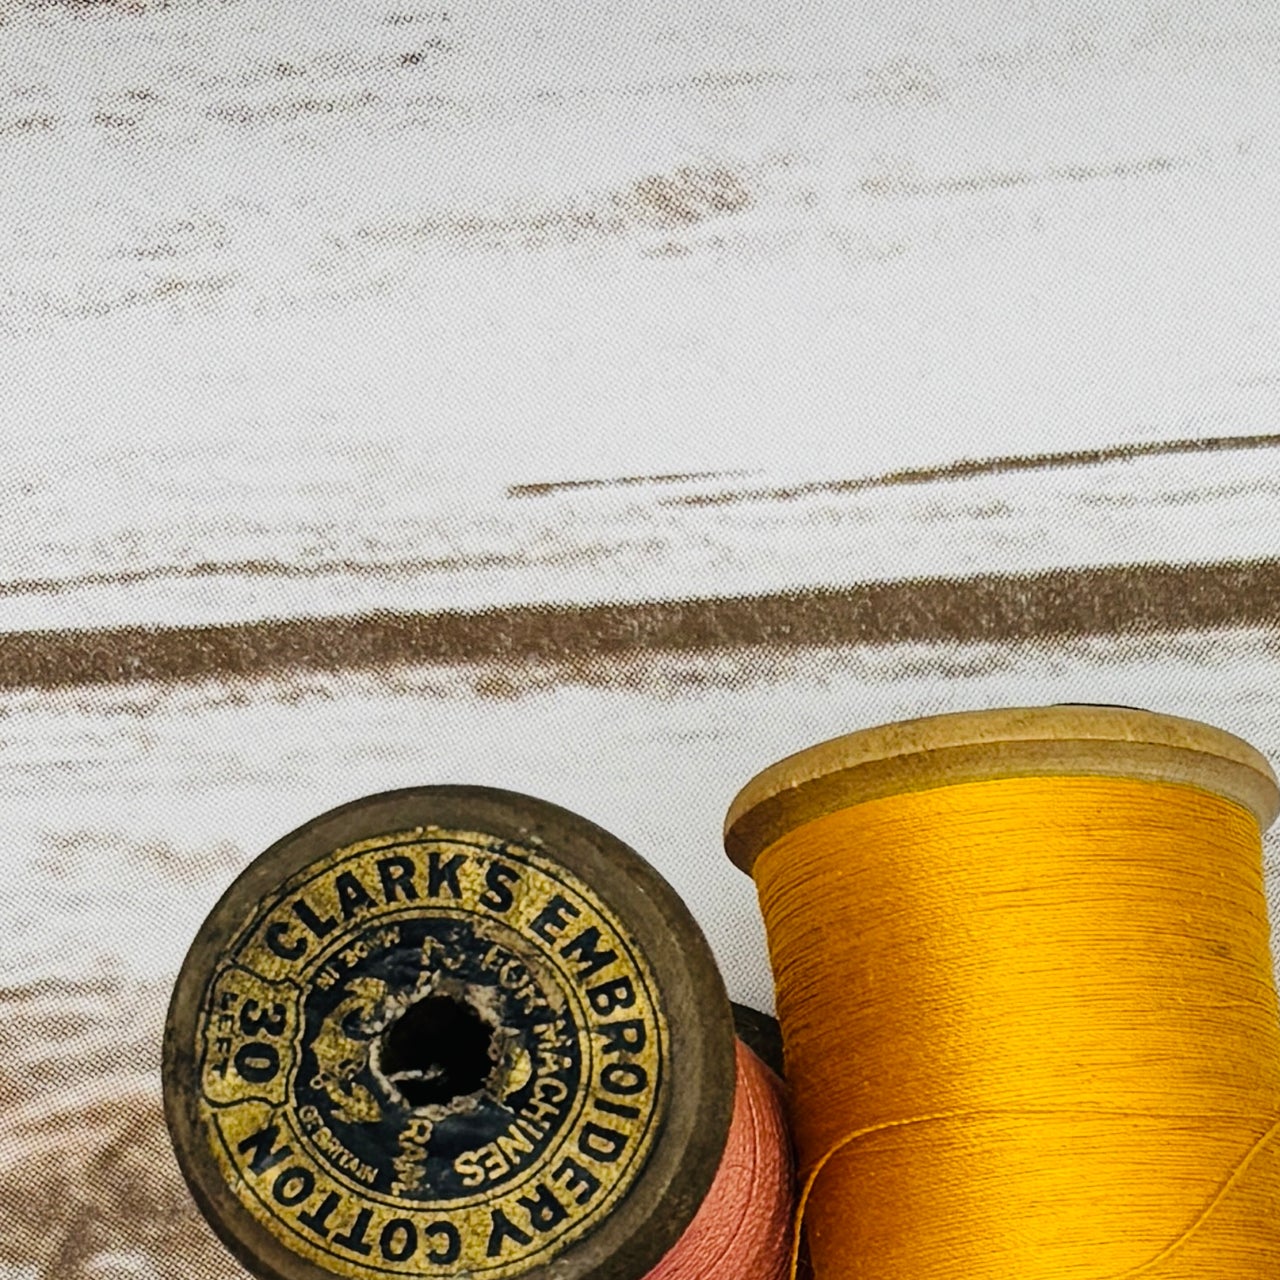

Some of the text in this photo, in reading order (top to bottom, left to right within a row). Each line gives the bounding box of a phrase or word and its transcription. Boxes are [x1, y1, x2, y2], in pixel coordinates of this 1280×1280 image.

[234, 998, 287, 1083] 30
[238, 851, 647, 1266] CLARK'S EMBROIDERY COTTON
[454, 1019, 574, 1187] MACHINES
